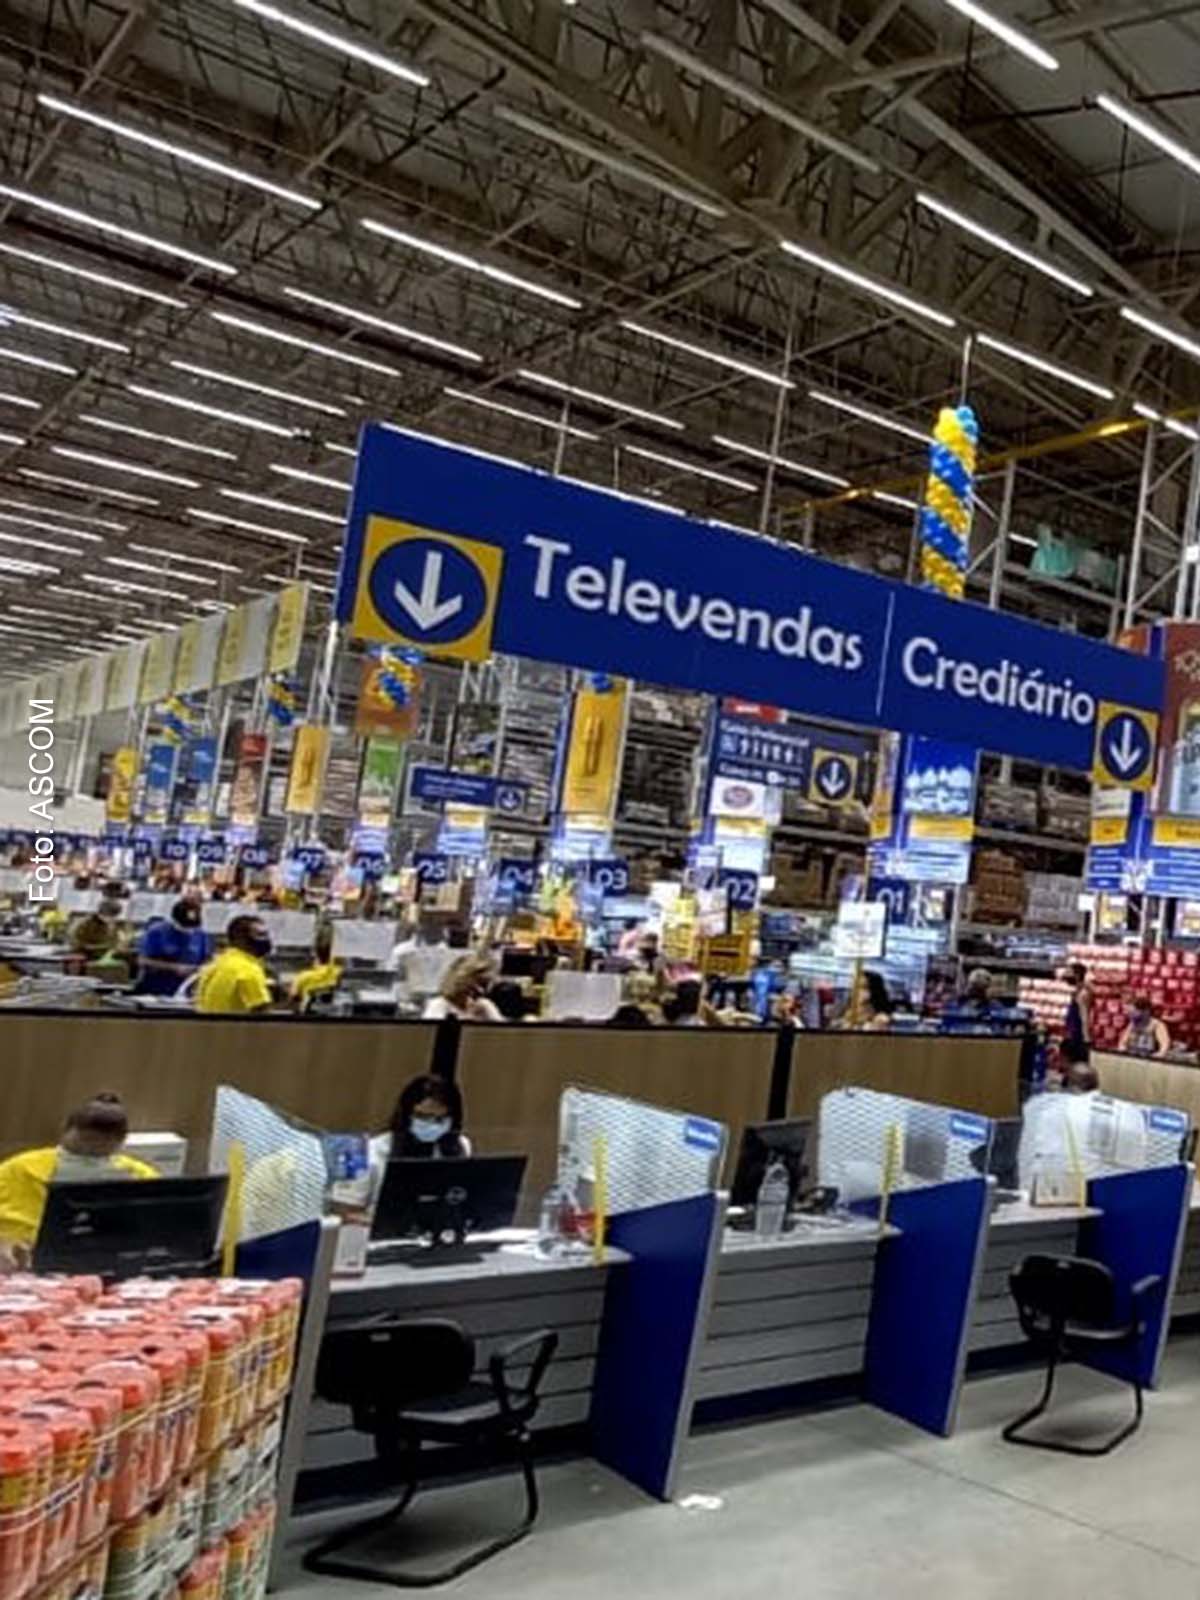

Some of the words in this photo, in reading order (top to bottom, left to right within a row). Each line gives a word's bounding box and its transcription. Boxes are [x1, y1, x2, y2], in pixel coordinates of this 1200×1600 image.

[523, 533, 863, 670] Televendas
[902, 636, 1096, 725] Crediário
[597, 867, 629, 889] 03
[724, 877, 756, 902] 02
